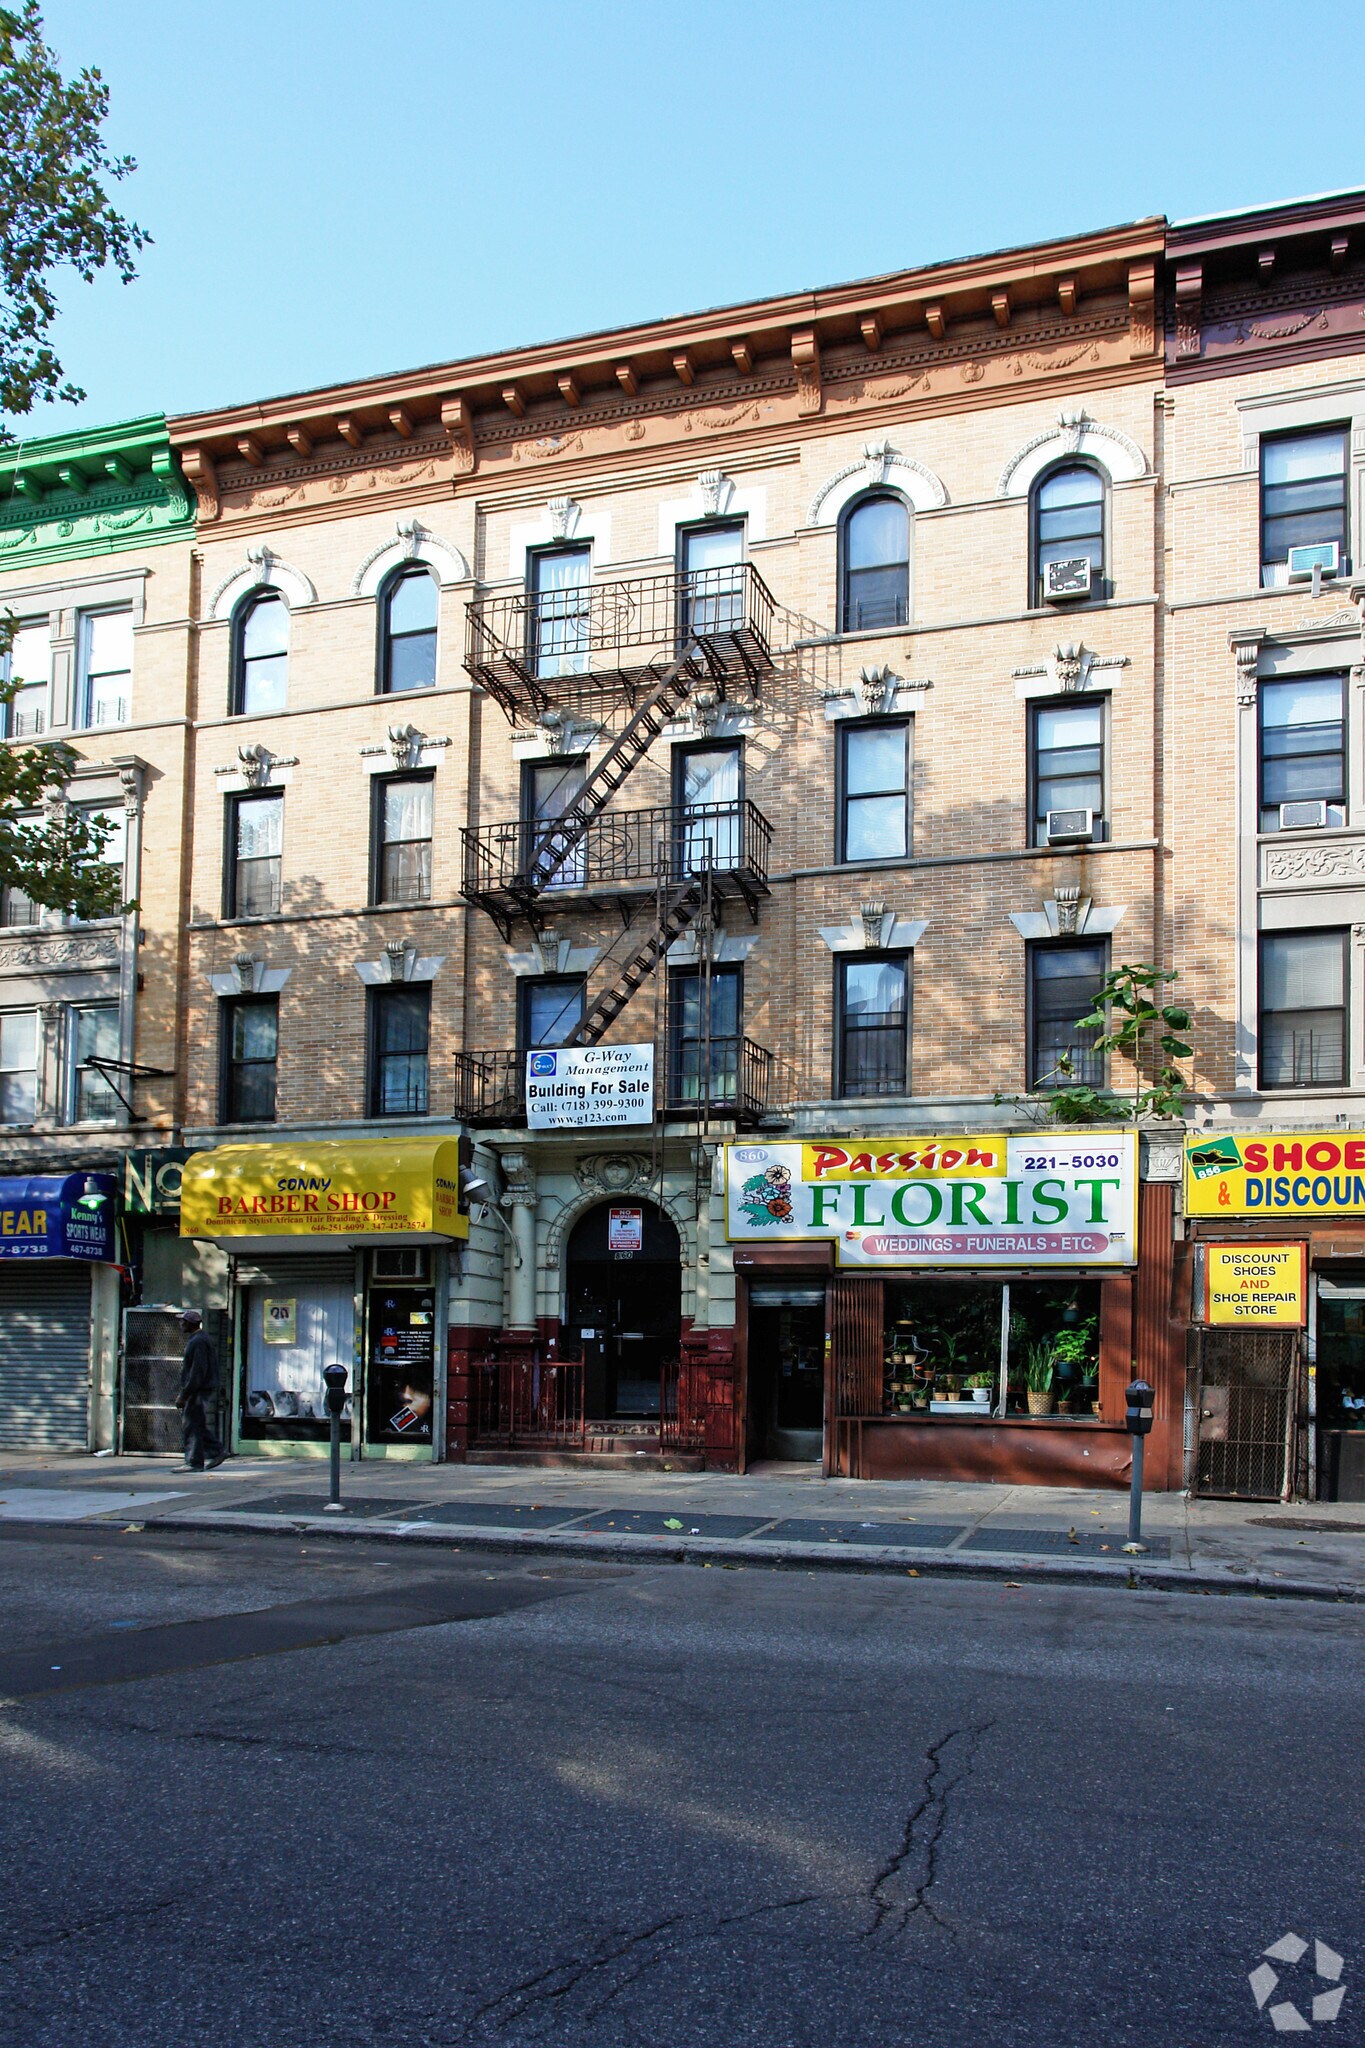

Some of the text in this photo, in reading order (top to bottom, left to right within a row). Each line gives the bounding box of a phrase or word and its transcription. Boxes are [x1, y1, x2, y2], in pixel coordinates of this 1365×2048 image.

[585, 1050, 632, 1063] G-Way
[566, 1063, 649, 1075] Management
[529, 1079, 650, 1099] Building For Sale
[531, 1098, 645, 1113] Call: (718) 399-9300
[548, 1113, 627, 1125] www.g123.com
[739, 1150, 765, 1160] 860
[811, 1144, 1119, 1178] Passion 221-5030
[1243, 1141, 1365, 1173] SHOE
[1197, 1165, 1221, 1179] 856
[277, 1177, 332, 1192] SONNY
[1218, 1181, 1231, 1206] &
[218, 1191, 396, 1214] BARBER SHOP
[807, 1179, 1120, 1228] FLORIST
[71, 1207, 103, 1223] Kenny's
[248, 1217, 273, 1226] Stylist
[274, 1216, 304, 1224] African
[306, 1215, 324, 1223] Hair
[326, 1214, 361, 1223] Braiding
[373, 1213, 408, 1222] Dressing
[0, 1210, 47, 1235] EAR
[66, 1223, 106, 1241] SPORTS WEAR
[70, 1244, 103, 1256] 467-8738
[874, 1236, 1096, 1251] WEDDINGS FUNERALS ETC.
[1221, 1253, 1290, 1264] DISCOUNT
[1233, 1266, 1276, 1276] SHOES
[1239, 1279, 1270, 1289] AND
[1213, 1292, 1297, 1302] SHOE REPAIR
[1234, 1305, 1277, 1315] STORE
